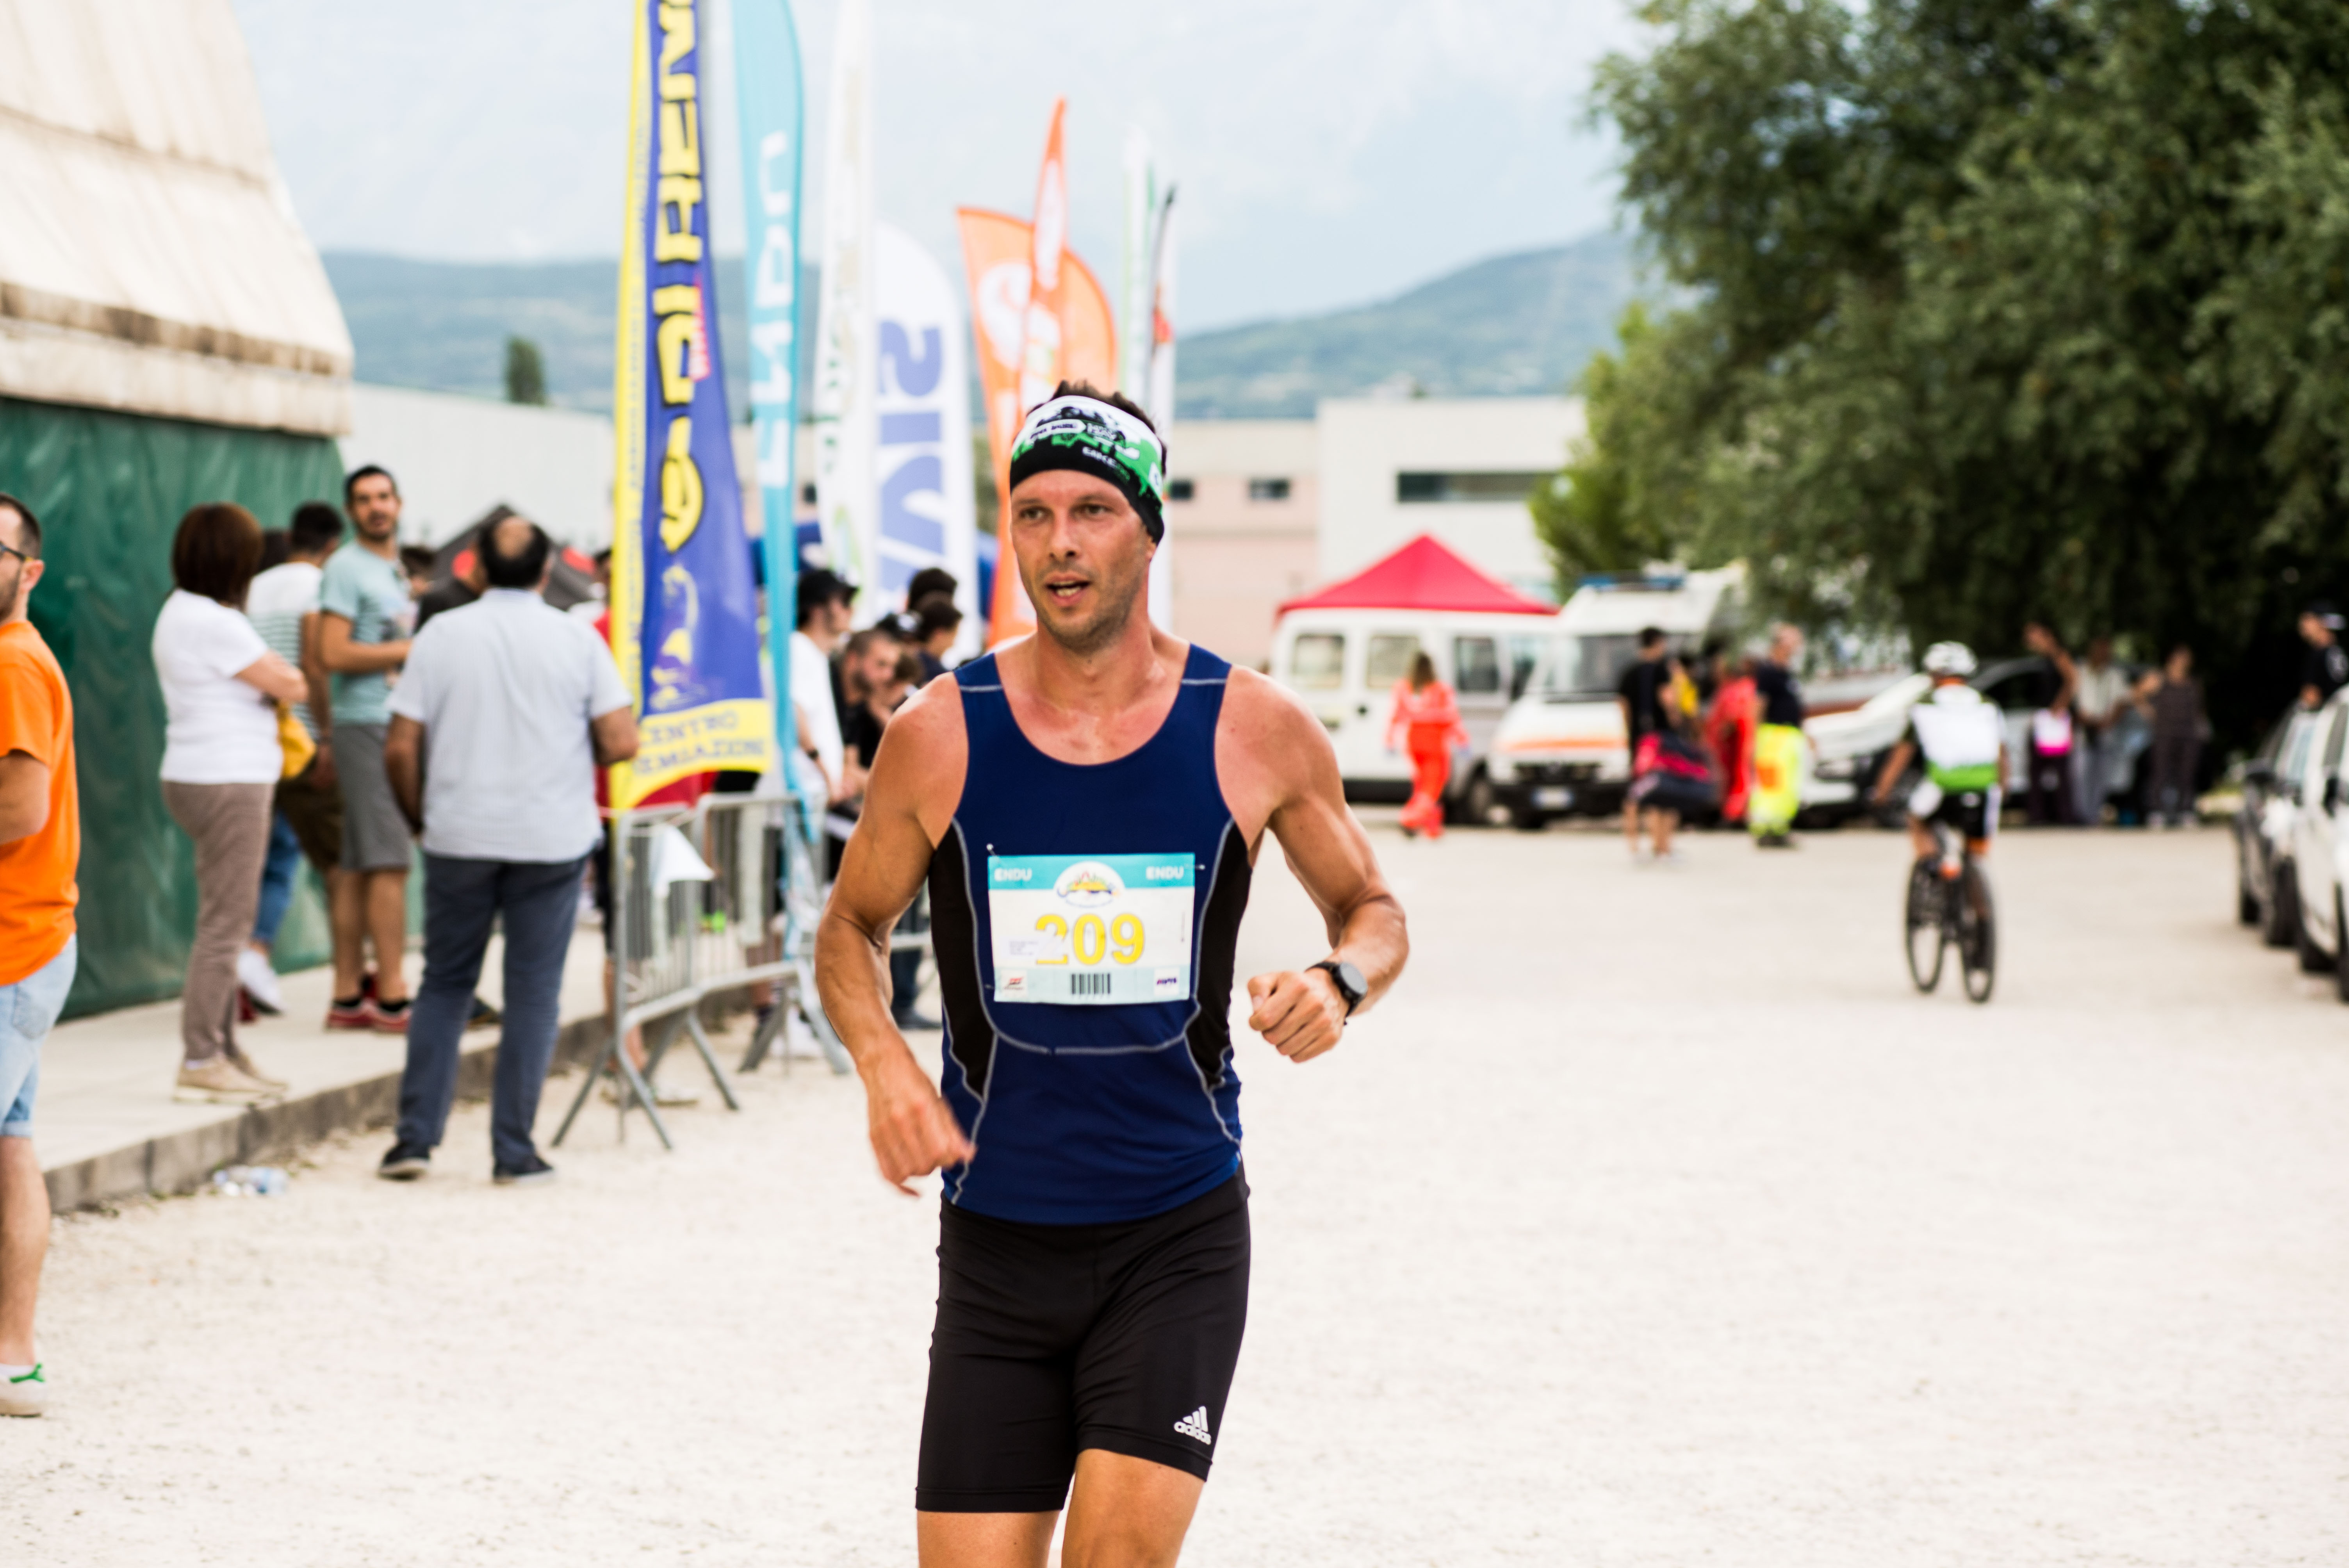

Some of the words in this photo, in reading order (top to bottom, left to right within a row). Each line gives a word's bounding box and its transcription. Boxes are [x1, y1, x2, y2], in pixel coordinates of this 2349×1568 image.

[654, 0, 702, 263] REN
[646, 710, 738, 744] ENTRO
[994, 868, 1032, 882] ENDU
[1146, 866, 1184, 880] ENDU
[1035, 913, 1145, 965] 209
[1174, 1421, 1212, 1445] adidas
